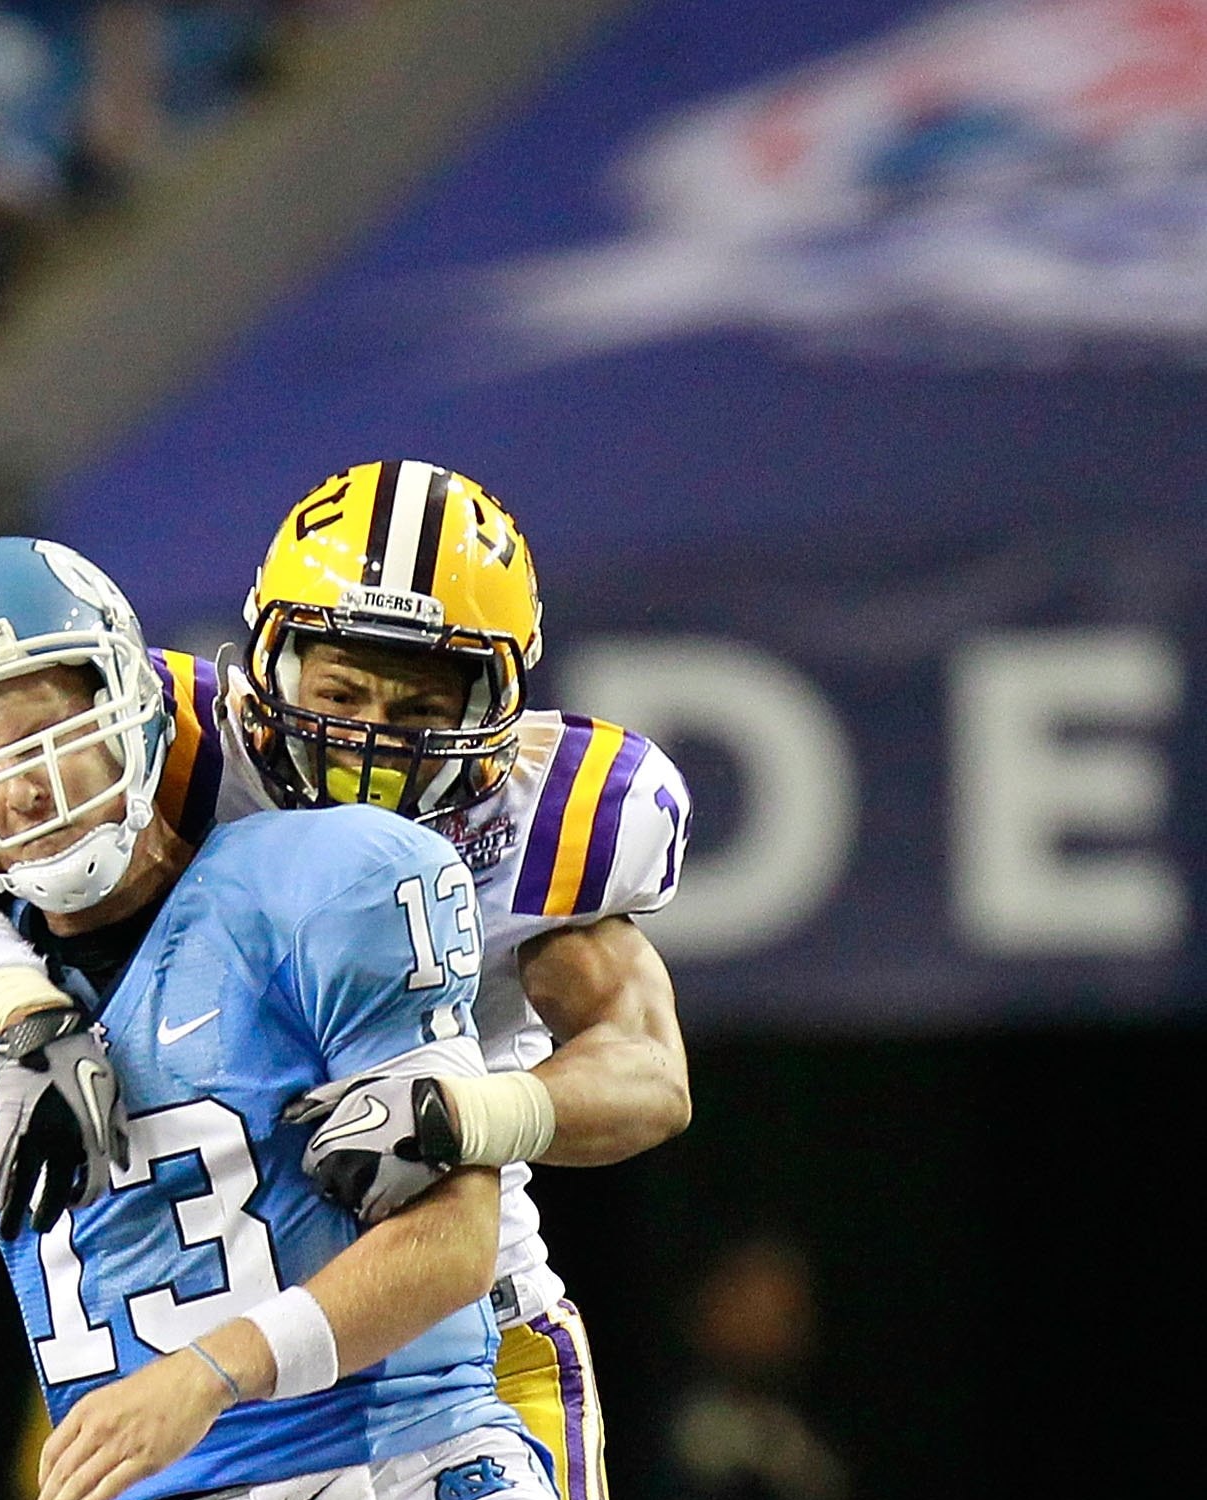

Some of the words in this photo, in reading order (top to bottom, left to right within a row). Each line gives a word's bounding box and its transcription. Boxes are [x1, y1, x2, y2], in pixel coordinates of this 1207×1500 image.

[363, 591, 413, 612] TIGERS
[394, 861, 481, 992] 13
[34, 1095, 283, 1386] 13
